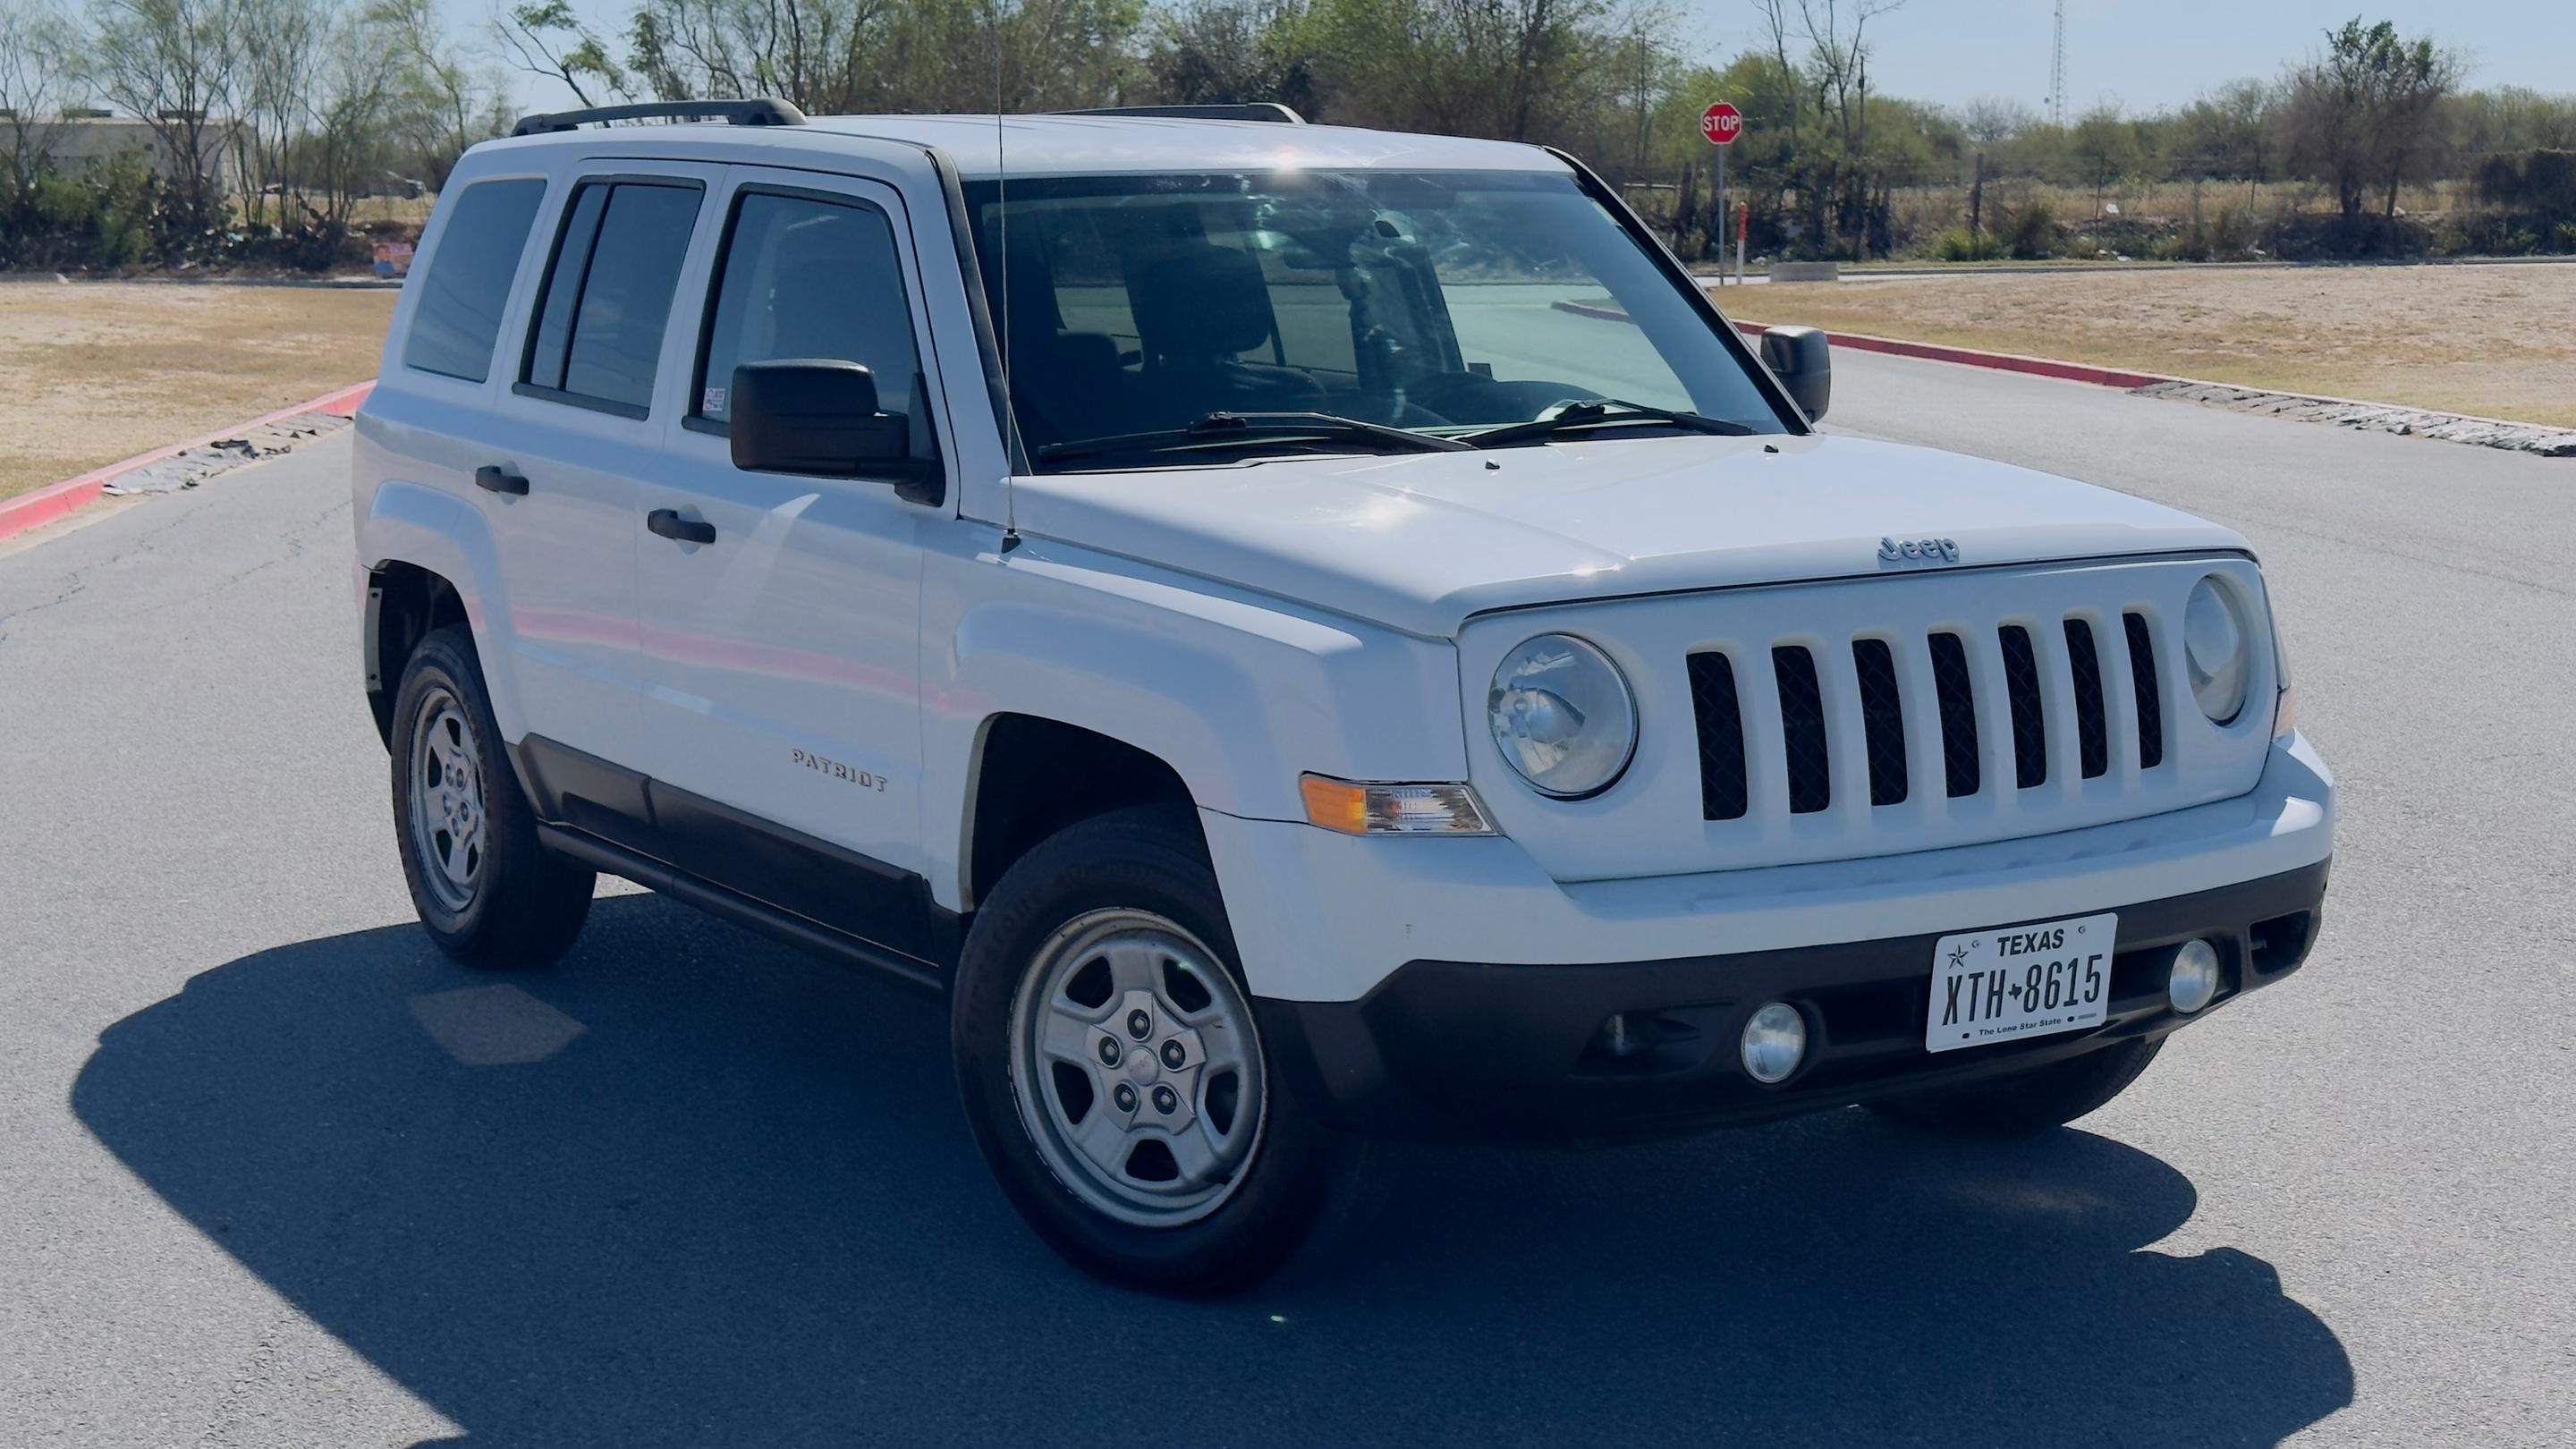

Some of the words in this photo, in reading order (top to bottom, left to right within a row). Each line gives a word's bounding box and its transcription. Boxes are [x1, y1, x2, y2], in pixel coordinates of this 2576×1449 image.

[1703, 115, 1739, 131] STOP
[1877, 537, 1960, 563] Jeep
[791, 748, 888, 792] PATRIOT
[1997, 928, 2064, 957] TEXAS
[1942, 969, 2006, 1026] XTH
[2022, 953, 2103, 1013] 8615
[1979, 1029, 1995, 1037] The
[1996, 1025, 2018, 1034] Lone
[2020, 1021, 2037, 1030] Star
[2038, 1018, 2062, 1027] State
